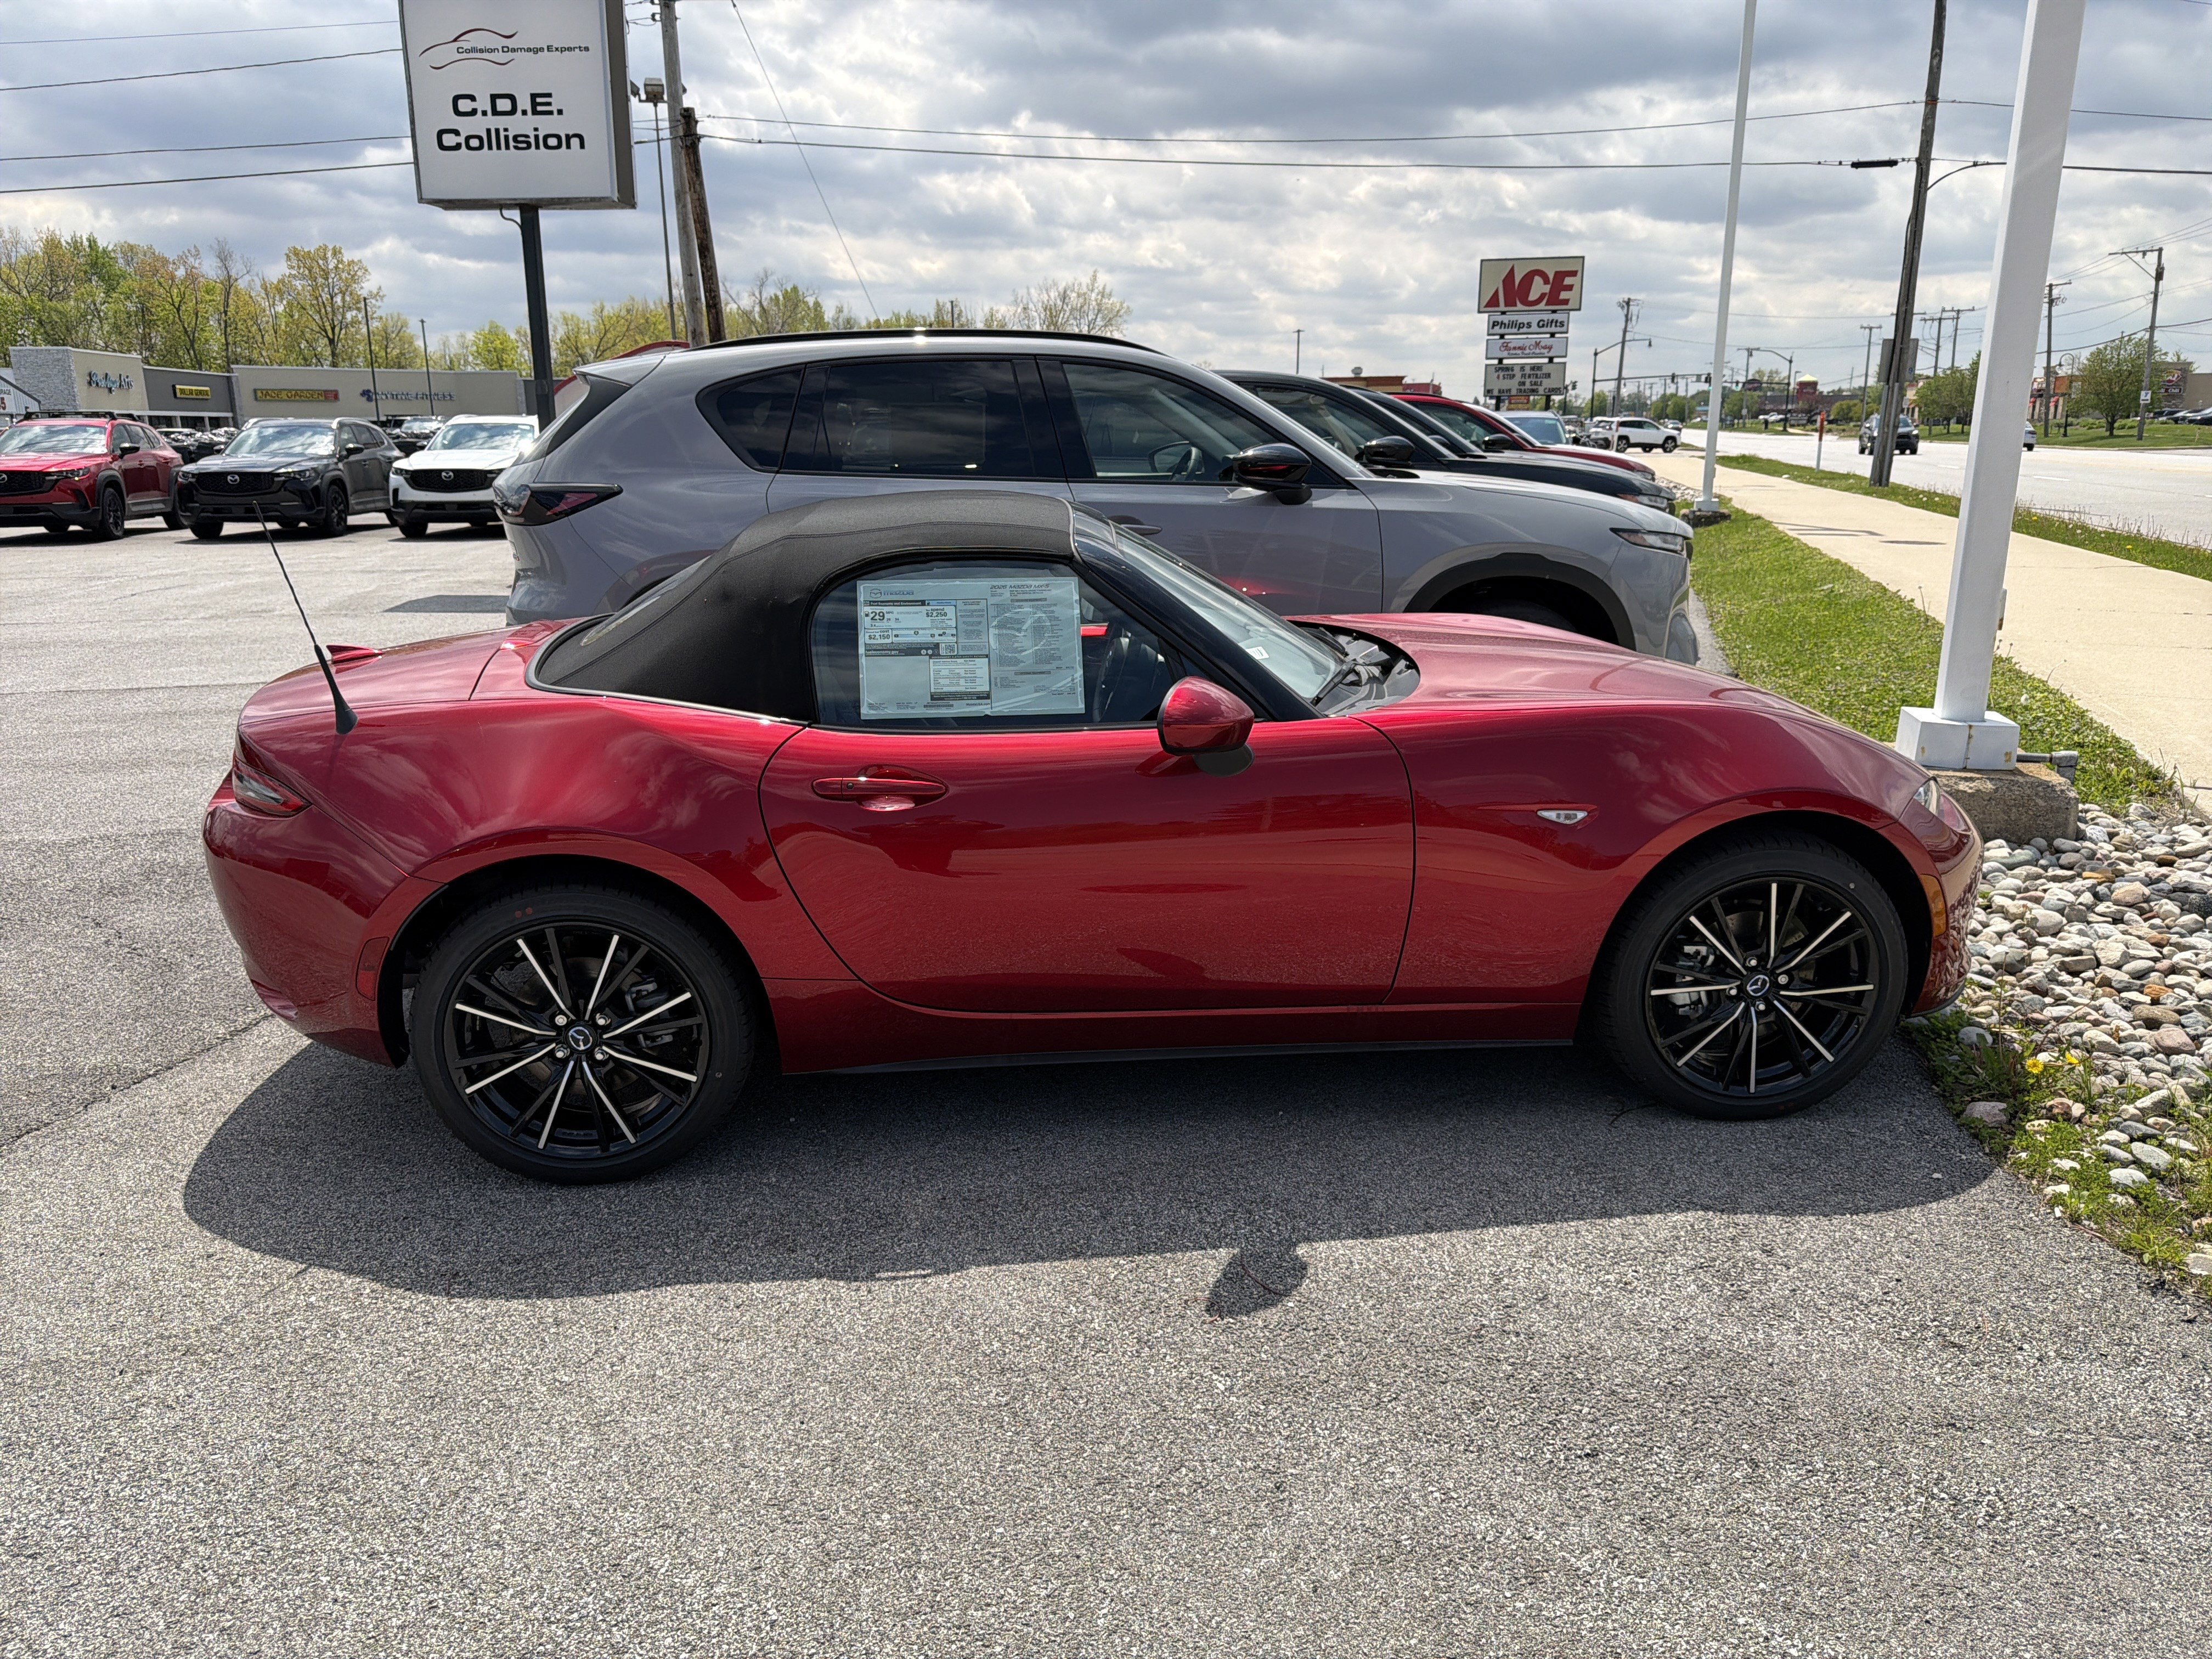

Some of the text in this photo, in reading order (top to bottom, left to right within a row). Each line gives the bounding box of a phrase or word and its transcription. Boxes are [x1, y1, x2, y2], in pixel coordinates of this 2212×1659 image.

[456, 44, 590, 54] Collision Damage Experts
[452, 93, 564, 117] C.D.E.
[437, 127, 585, 151] Collision
[1483, 264, 1578, 308] ACE
[1491, 319, 1565, 331] Philips Gifts
[1528, 340, 1554, 354] May
[870, 611, 885, 621] 29
